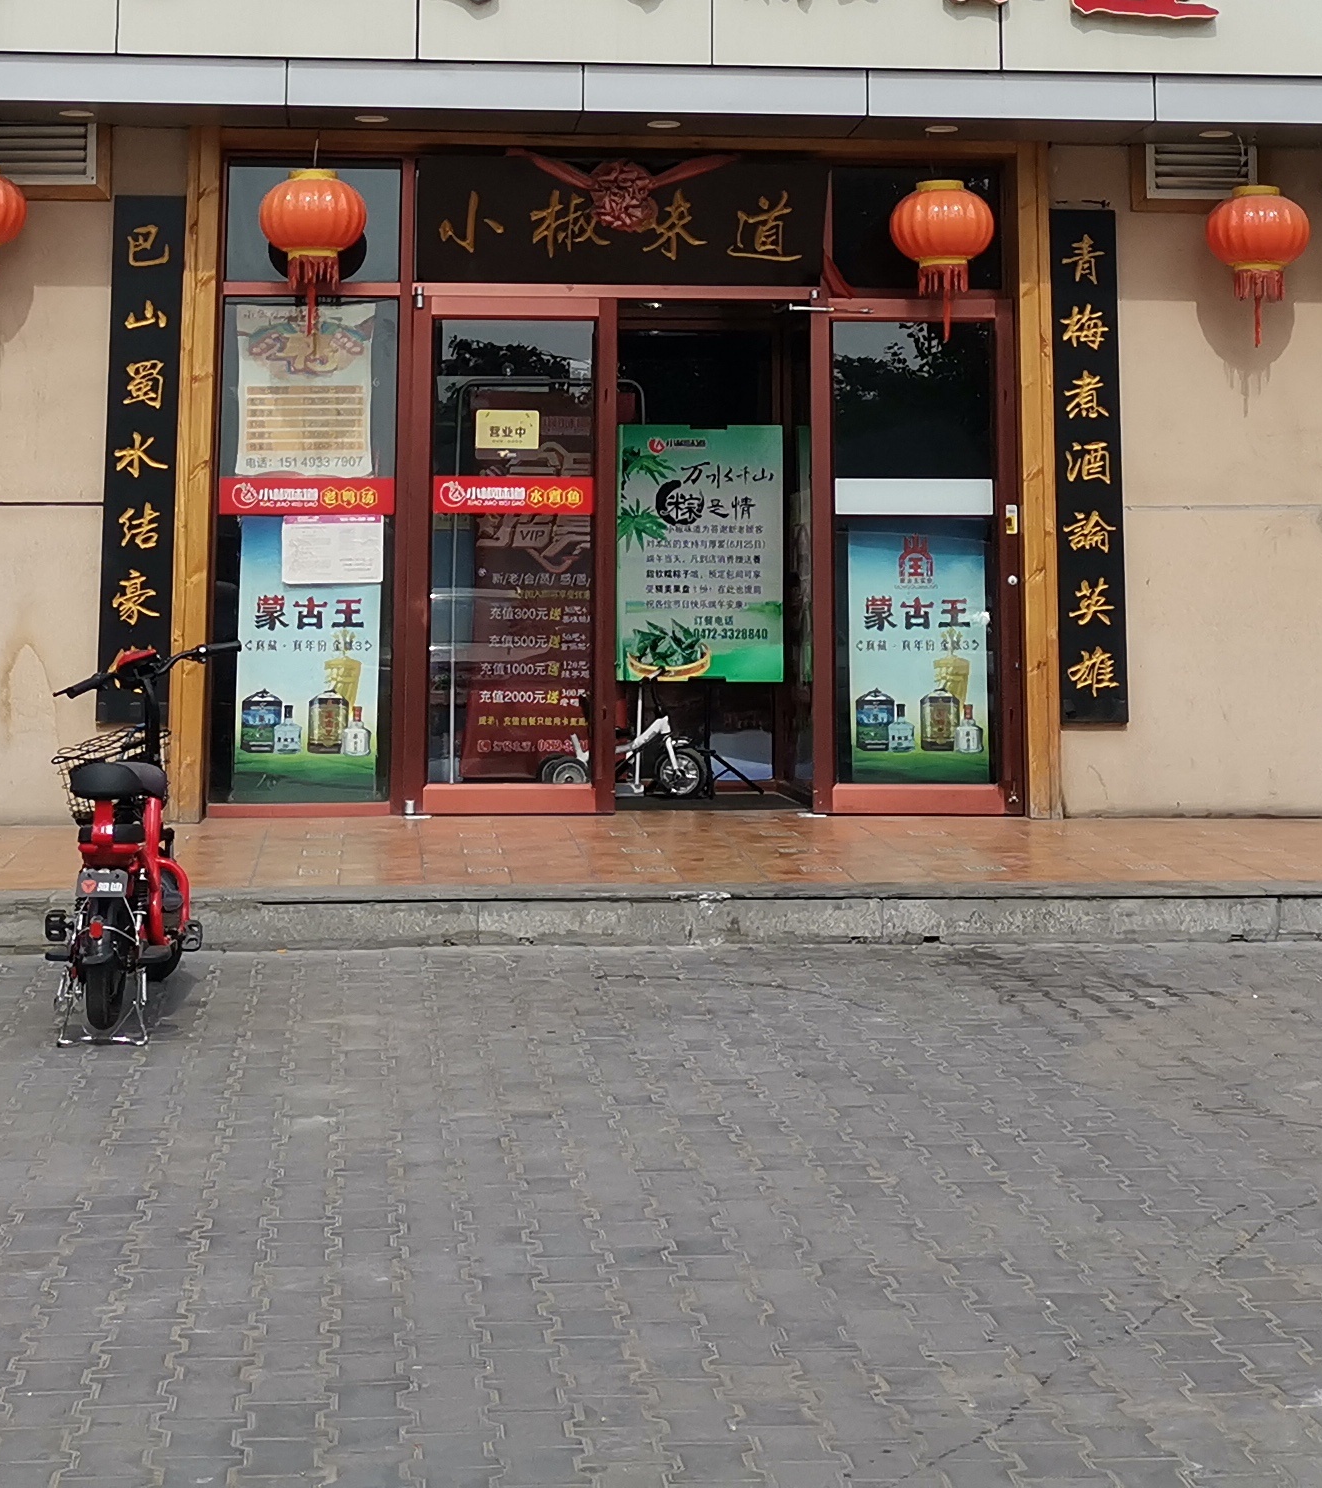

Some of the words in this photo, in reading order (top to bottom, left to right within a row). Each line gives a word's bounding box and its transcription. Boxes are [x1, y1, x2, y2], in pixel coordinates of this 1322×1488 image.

[489, 425, 527, 438] 营业中
[107, 225, 170, 694] 巴山蜀水结豪
[278, 456, 298, 467] 151
[520, 530, 546, 542] VIP
[254, 594, 365, 631] 蒙古王
[864, 595, 971, 631] 蒙古王
